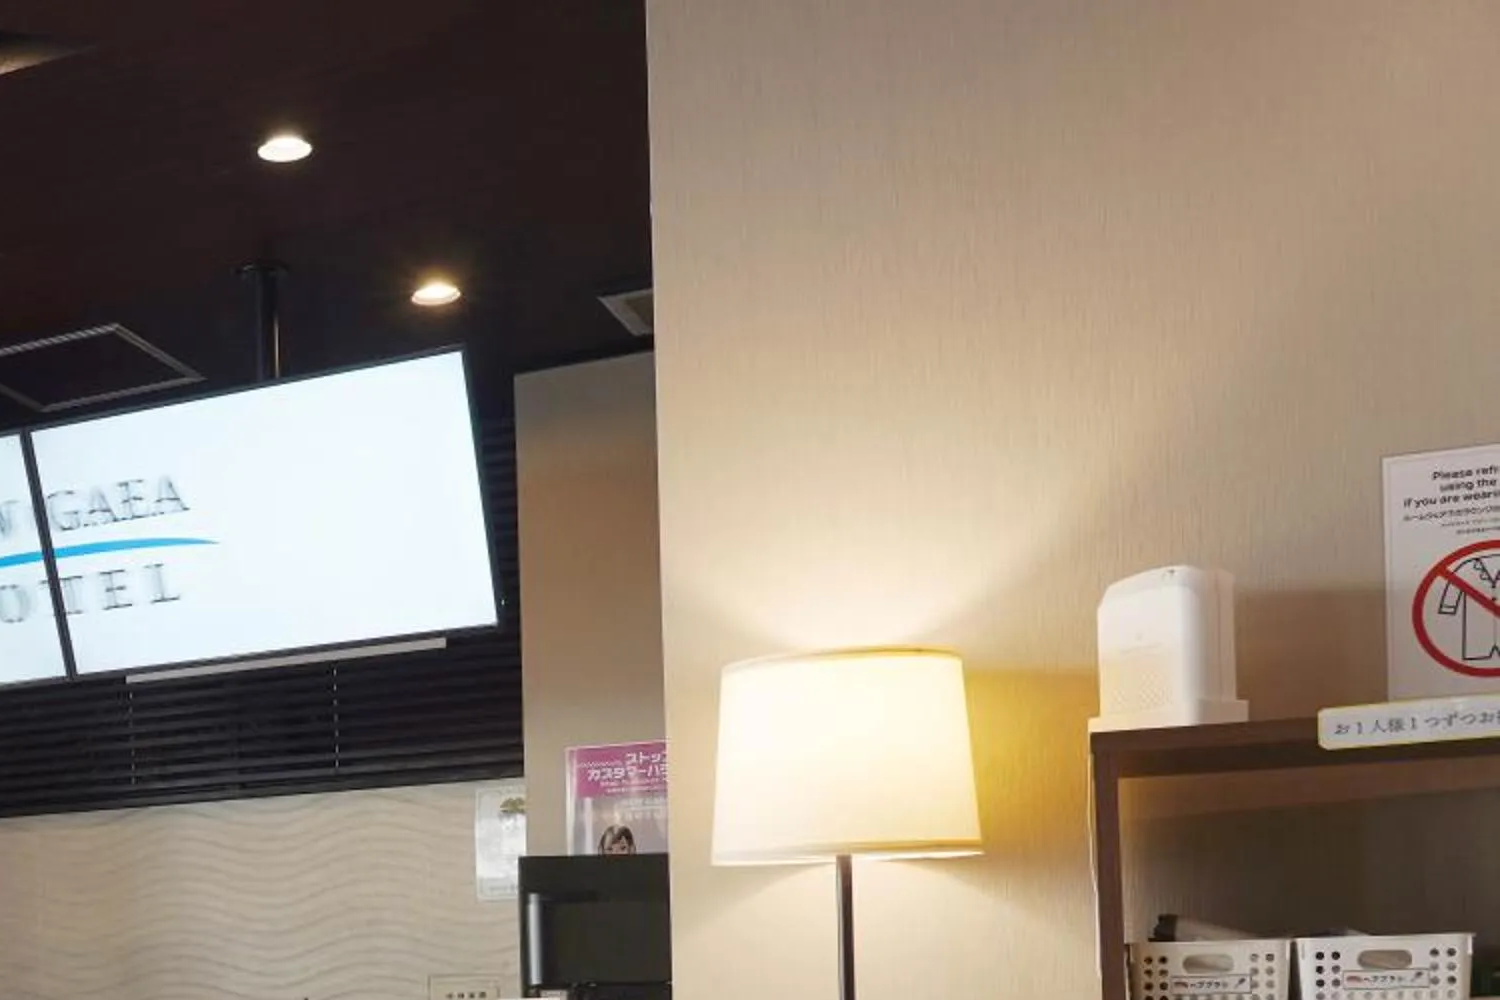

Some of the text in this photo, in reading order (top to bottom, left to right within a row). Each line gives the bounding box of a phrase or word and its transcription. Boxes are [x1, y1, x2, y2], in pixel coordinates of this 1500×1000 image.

[1431, 469, 1473, 480] Please
[1440, 479, 1497, 492] using the
[46, 474, 191, 531] GAEA
[1414, 498, 1437, 508] you
[1439, 496, 1460, 504] are
[625, 751, 666, 766] ストッ
